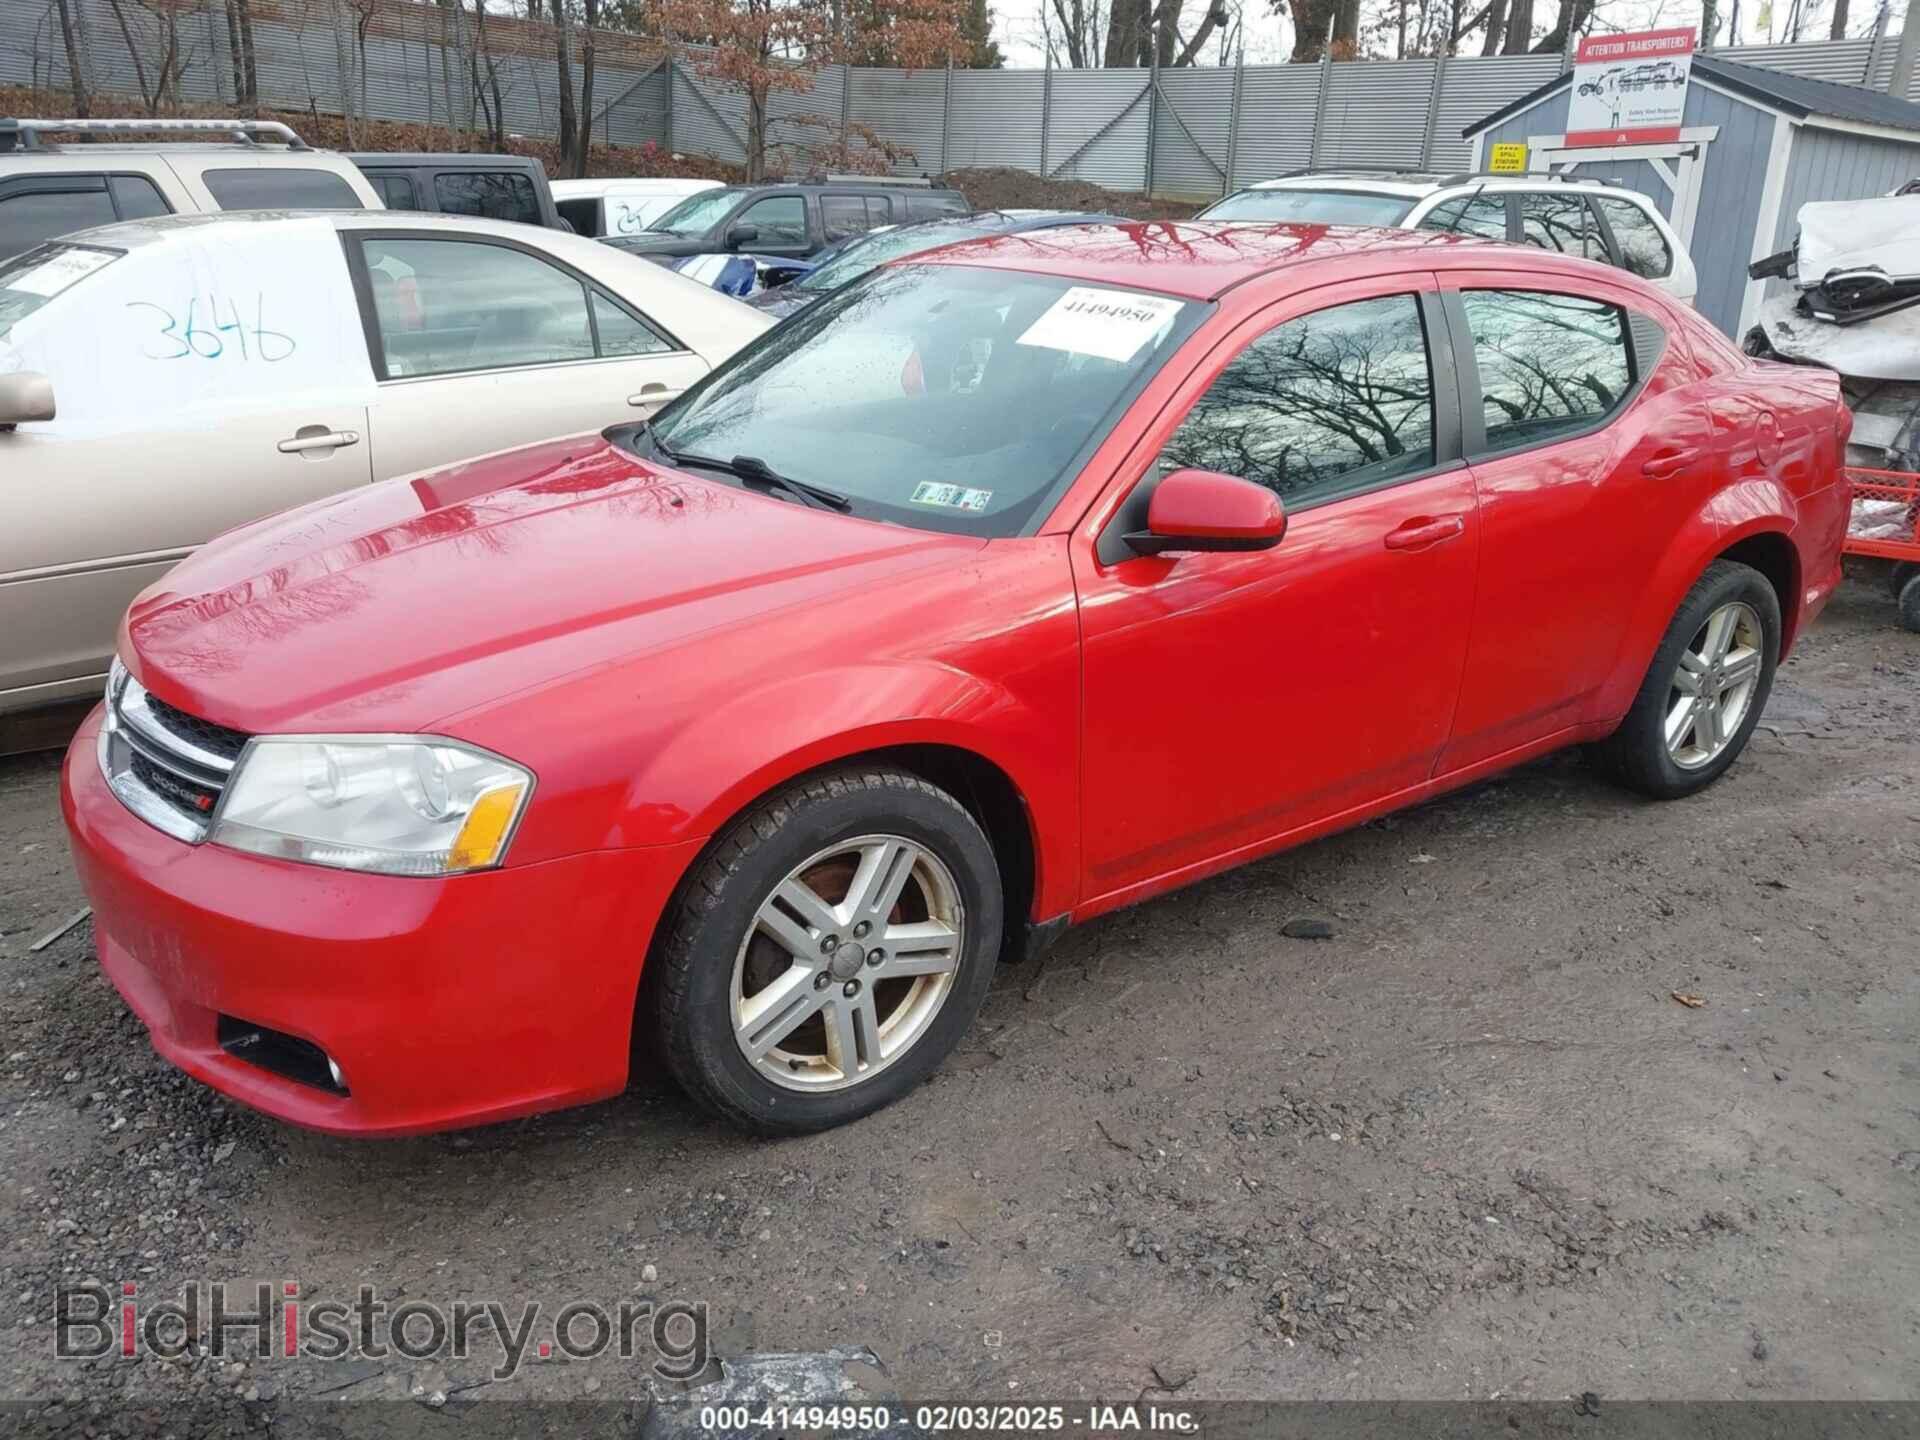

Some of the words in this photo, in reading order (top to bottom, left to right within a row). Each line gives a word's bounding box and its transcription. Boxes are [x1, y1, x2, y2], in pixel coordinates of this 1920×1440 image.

[1585, 41, 1625, 56] ATTENTION
[1627, 36, 1688, 52] TRANSPORTERS!
[1063, 301, 1155, 322] 41494950
[126, 291, 296, 362] 3646
